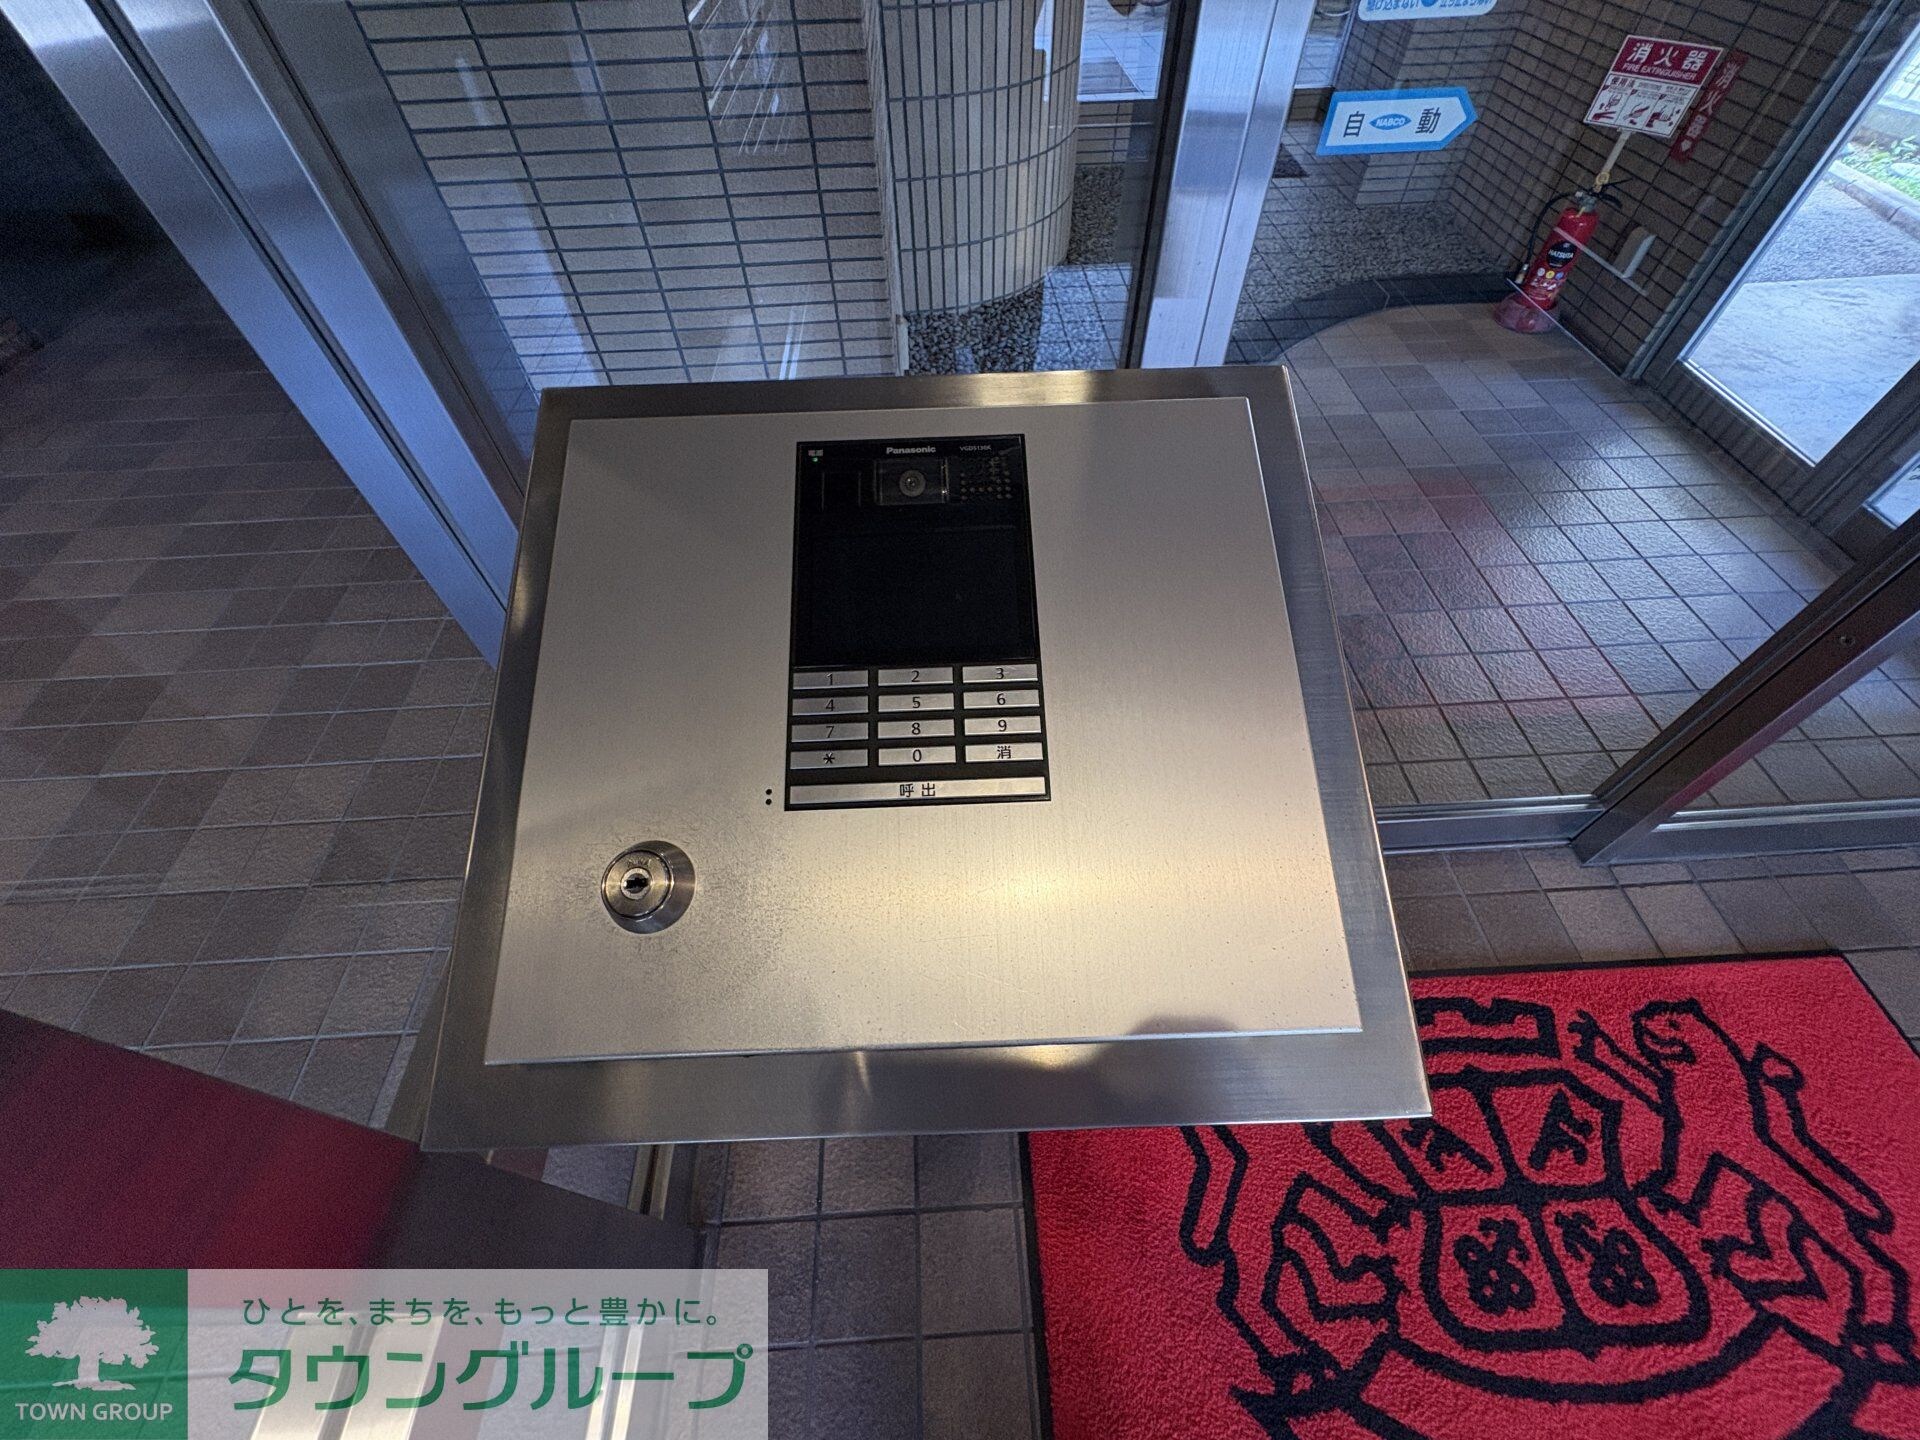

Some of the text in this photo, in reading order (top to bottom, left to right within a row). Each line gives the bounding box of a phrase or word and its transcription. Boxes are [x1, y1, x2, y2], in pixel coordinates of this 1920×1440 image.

[1626, 42, 1708, 71] 消火器
[1621, 62, 1698, 80] FIRE EXTINGUISHER
[1686, 61, 1740, 138] 消火器
[1343, 107, 1442, 137] 自 NABCO 動
[886, 445, 937, 455] Panasonic
[827, 667, 1005, 685] 1 2 3
[825, 692, 1006, 712] 4 5 6
[825, 719, 1007, 739] 7 8 9
[912, 749, 922, 763] 0
[996, 745, 1012, 760] 消
[899, 782, 937, 798] 呼出
